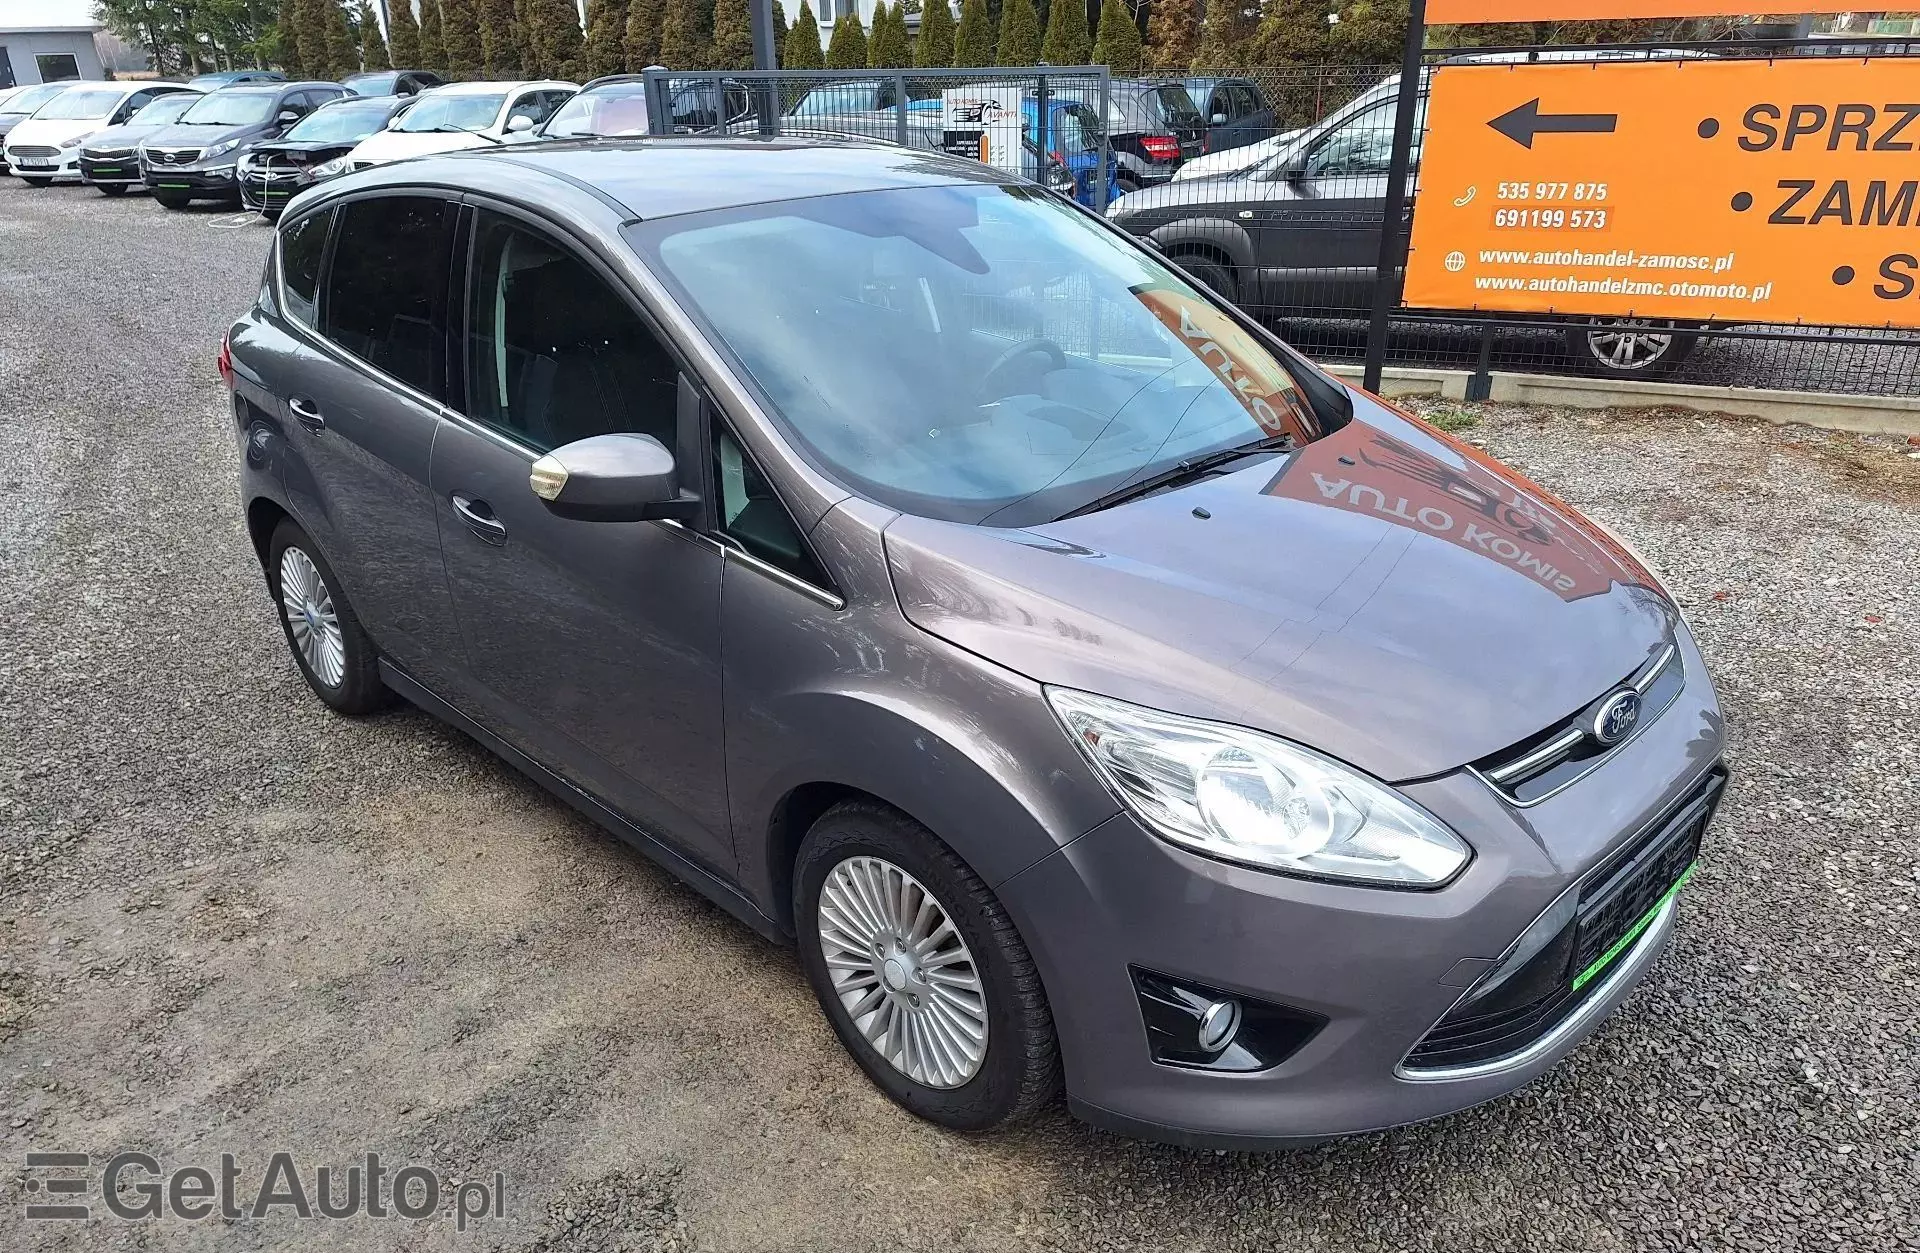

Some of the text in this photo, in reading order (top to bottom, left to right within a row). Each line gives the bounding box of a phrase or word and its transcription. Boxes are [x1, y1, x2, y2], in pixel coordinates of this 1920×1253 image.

[1737, 103, 1920, 152] SPRZ
[1497, 182, 1608, 201] 535 977 875
[1768, 179, 1920, 226] ZAM
[1570, 210, 1606, 229] 573
[1479, 249, 1735, 273] www.autohandel-zamosc.pl
[1873, 253, 1920, 299] S
[1475, 275, 1773, 301] www.autohandelzmc.otomoto.pl
[1612, 700, 1636, 734] Ford
